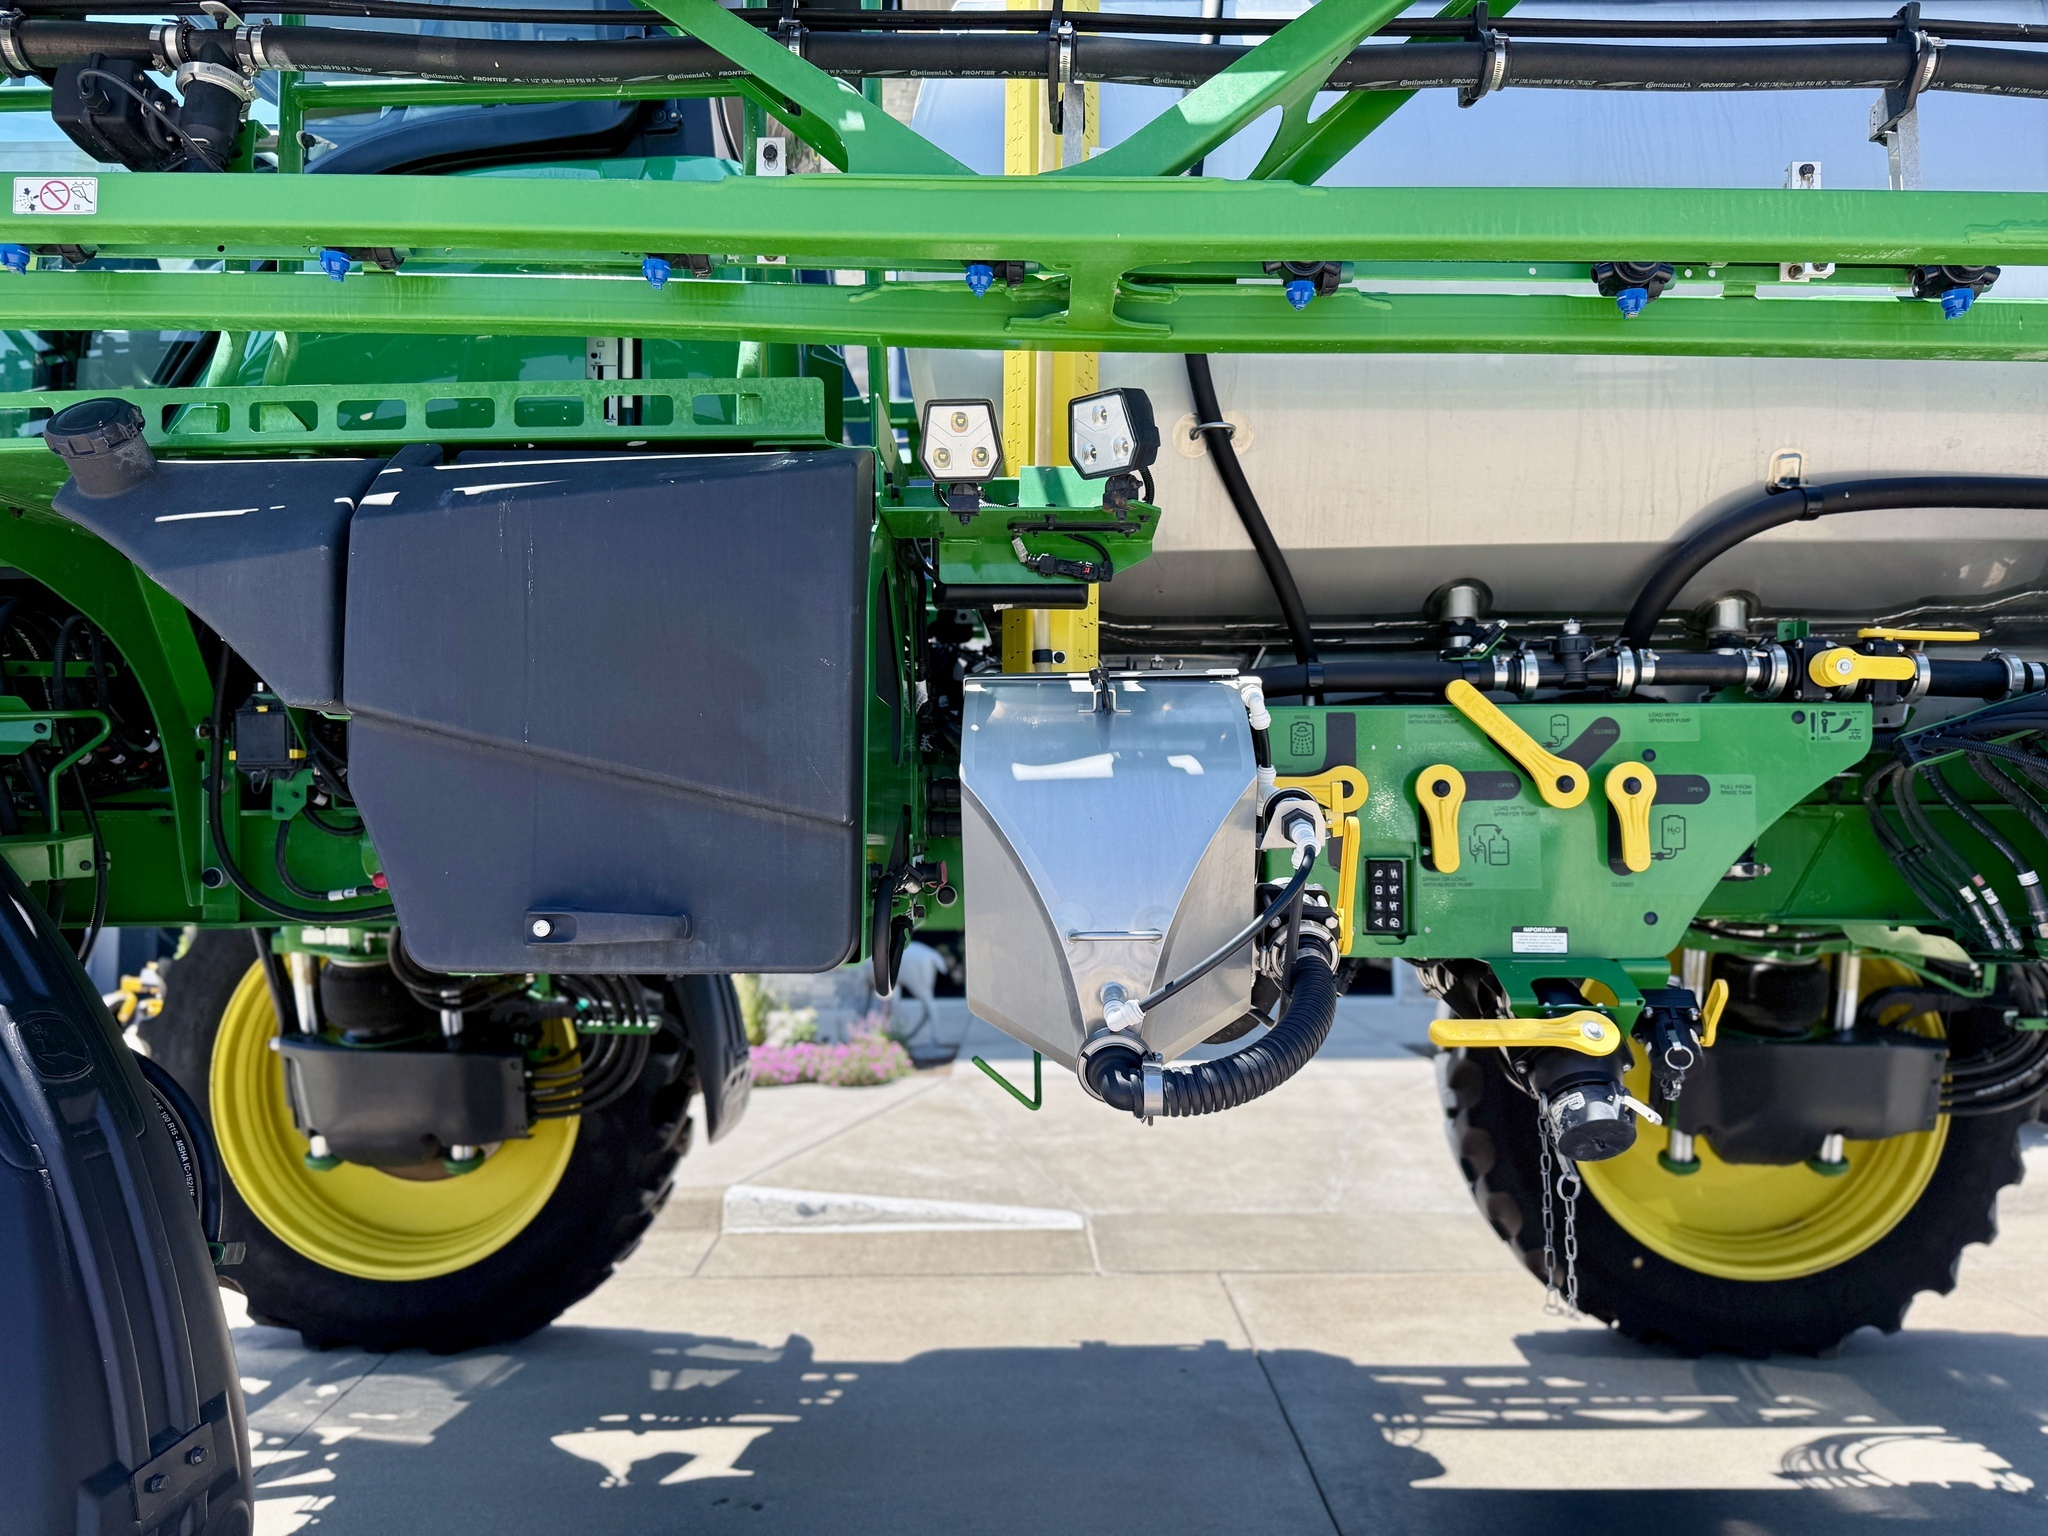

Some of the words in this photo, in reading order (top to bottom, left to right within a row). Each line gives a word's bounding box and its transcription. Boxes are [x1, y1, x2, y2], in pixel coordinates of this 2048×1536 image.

[420, 72, 460, 81] Continental
[667, 72, 705, 81] Continental
[909, 69, 949, 77] Continental
[1152, 76, 1191, 86] Continental
[1399, 79, 1438, 87] Continental
[1951, 82, 1988, 90] FRONTIER
[160, 1111, 171, 1123] 100
[167, 1121, 179, 1136] R15
[175, 1139, 189, 1163] MSHA
